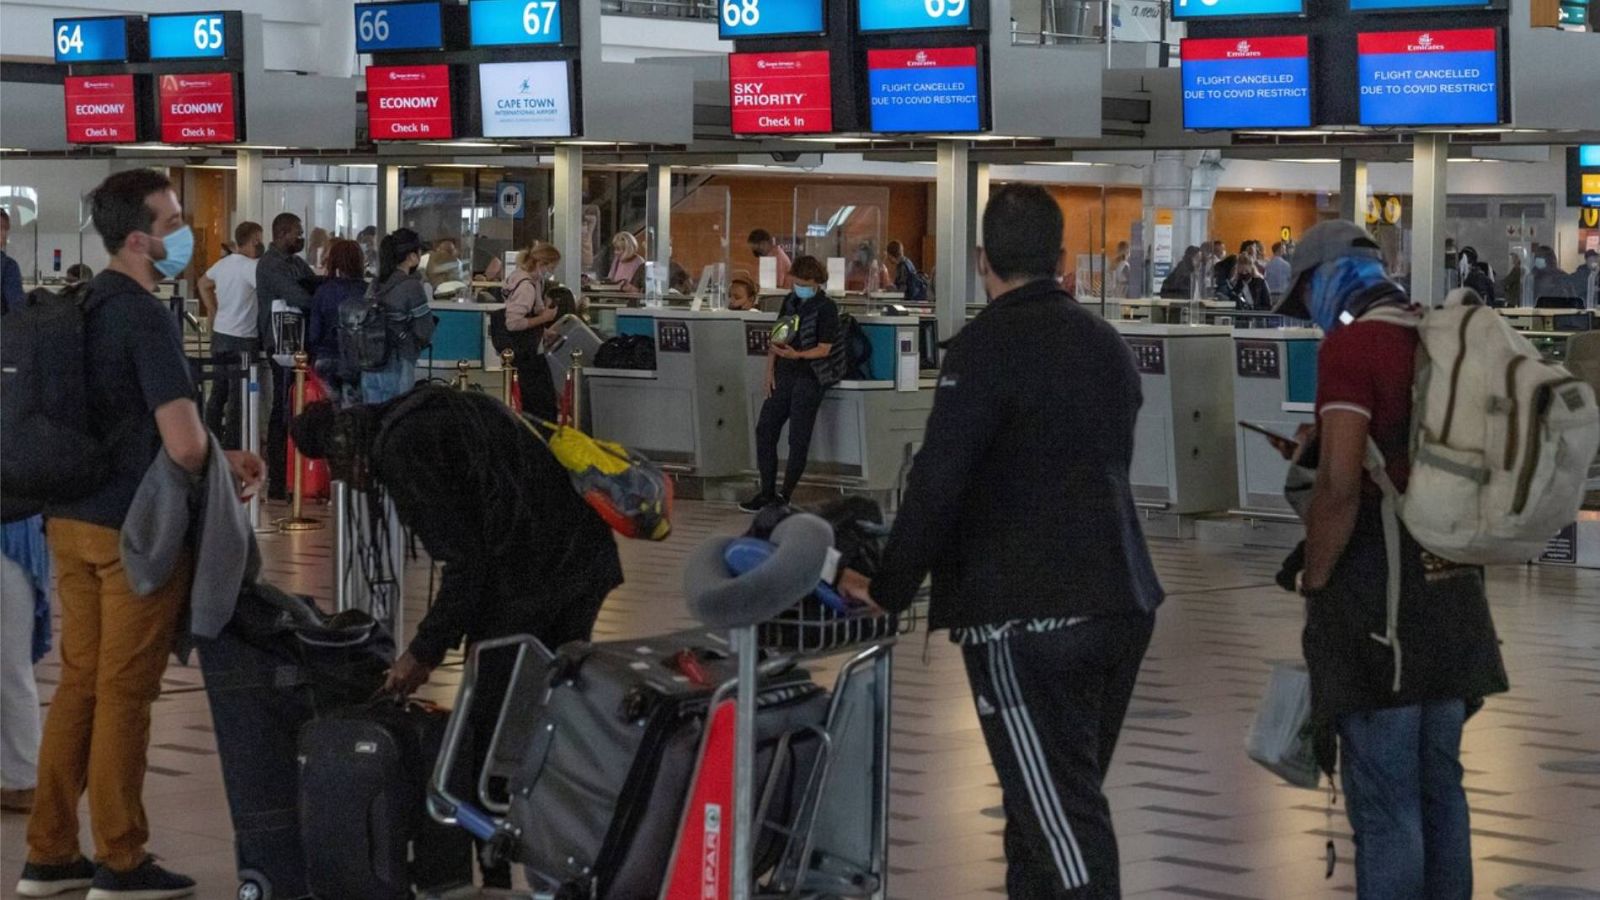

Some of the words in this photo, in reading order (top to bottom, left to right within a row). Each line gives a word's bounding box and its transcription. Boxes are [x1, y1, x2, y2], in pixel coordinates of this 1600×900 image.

[522, 1, 558, 35] 67
[723, 0, 760, 27] 68
[359, 9, 390, 42] 66
[193, 18, 222, 49] 65
[57, 25, 84, 54] 64
[1196, 76, 1231, 85] FLIGHT
[1233, 74, 1294, 84] CANCELLED
[1374, 70, 1412, 80] FLIGHT
[1415, 69, 1480, 79] CANCELLED
[734, 83, 763, 94] SKY
[881, 84, 912, 92] FLIGHT
[913, 83, 965, 92] CANCELLED
[1361, 84, 1383, 95] DUE
[1386, 84, 1401, 94] TO
[1403, 83, 1437, 94] COVID
[1440, 82, 1495, 93] RESTRICT
[1185, 90, 1205, 99] DUE
[1208, 90, 1222, 99] TO
[1223, 89, 1255, 98] COVID
[1257, 88, 1307, 97] RESTRICT
[379, 96, 439, 109] ECONOMY
[497, 99, 521, 109] CAPE
[523, 98, 555, 108] TOWN
[734, 94, 804, 106] PRIORITY
[872, 97, 889, 105] DUE
[892, 96, 904, 104] TO
[904, 96, 932, 104] COVID
[933, 95, 977, 104] RESTRICT
[75, 104, 125, 115] ECONOMY
[171, 103, 223, 114] ECONOMY
[758, 116, 790, 127] Check
[794, 116, 805, 126] In
[85, 127, 108, 137] Check
[110, 127, 118, 136] In
[181, 128, 205, 137] Check
[207, 127, 216, 136] In
[391, 122, 418, 133] Check
[420, 122, 430, 132] In
